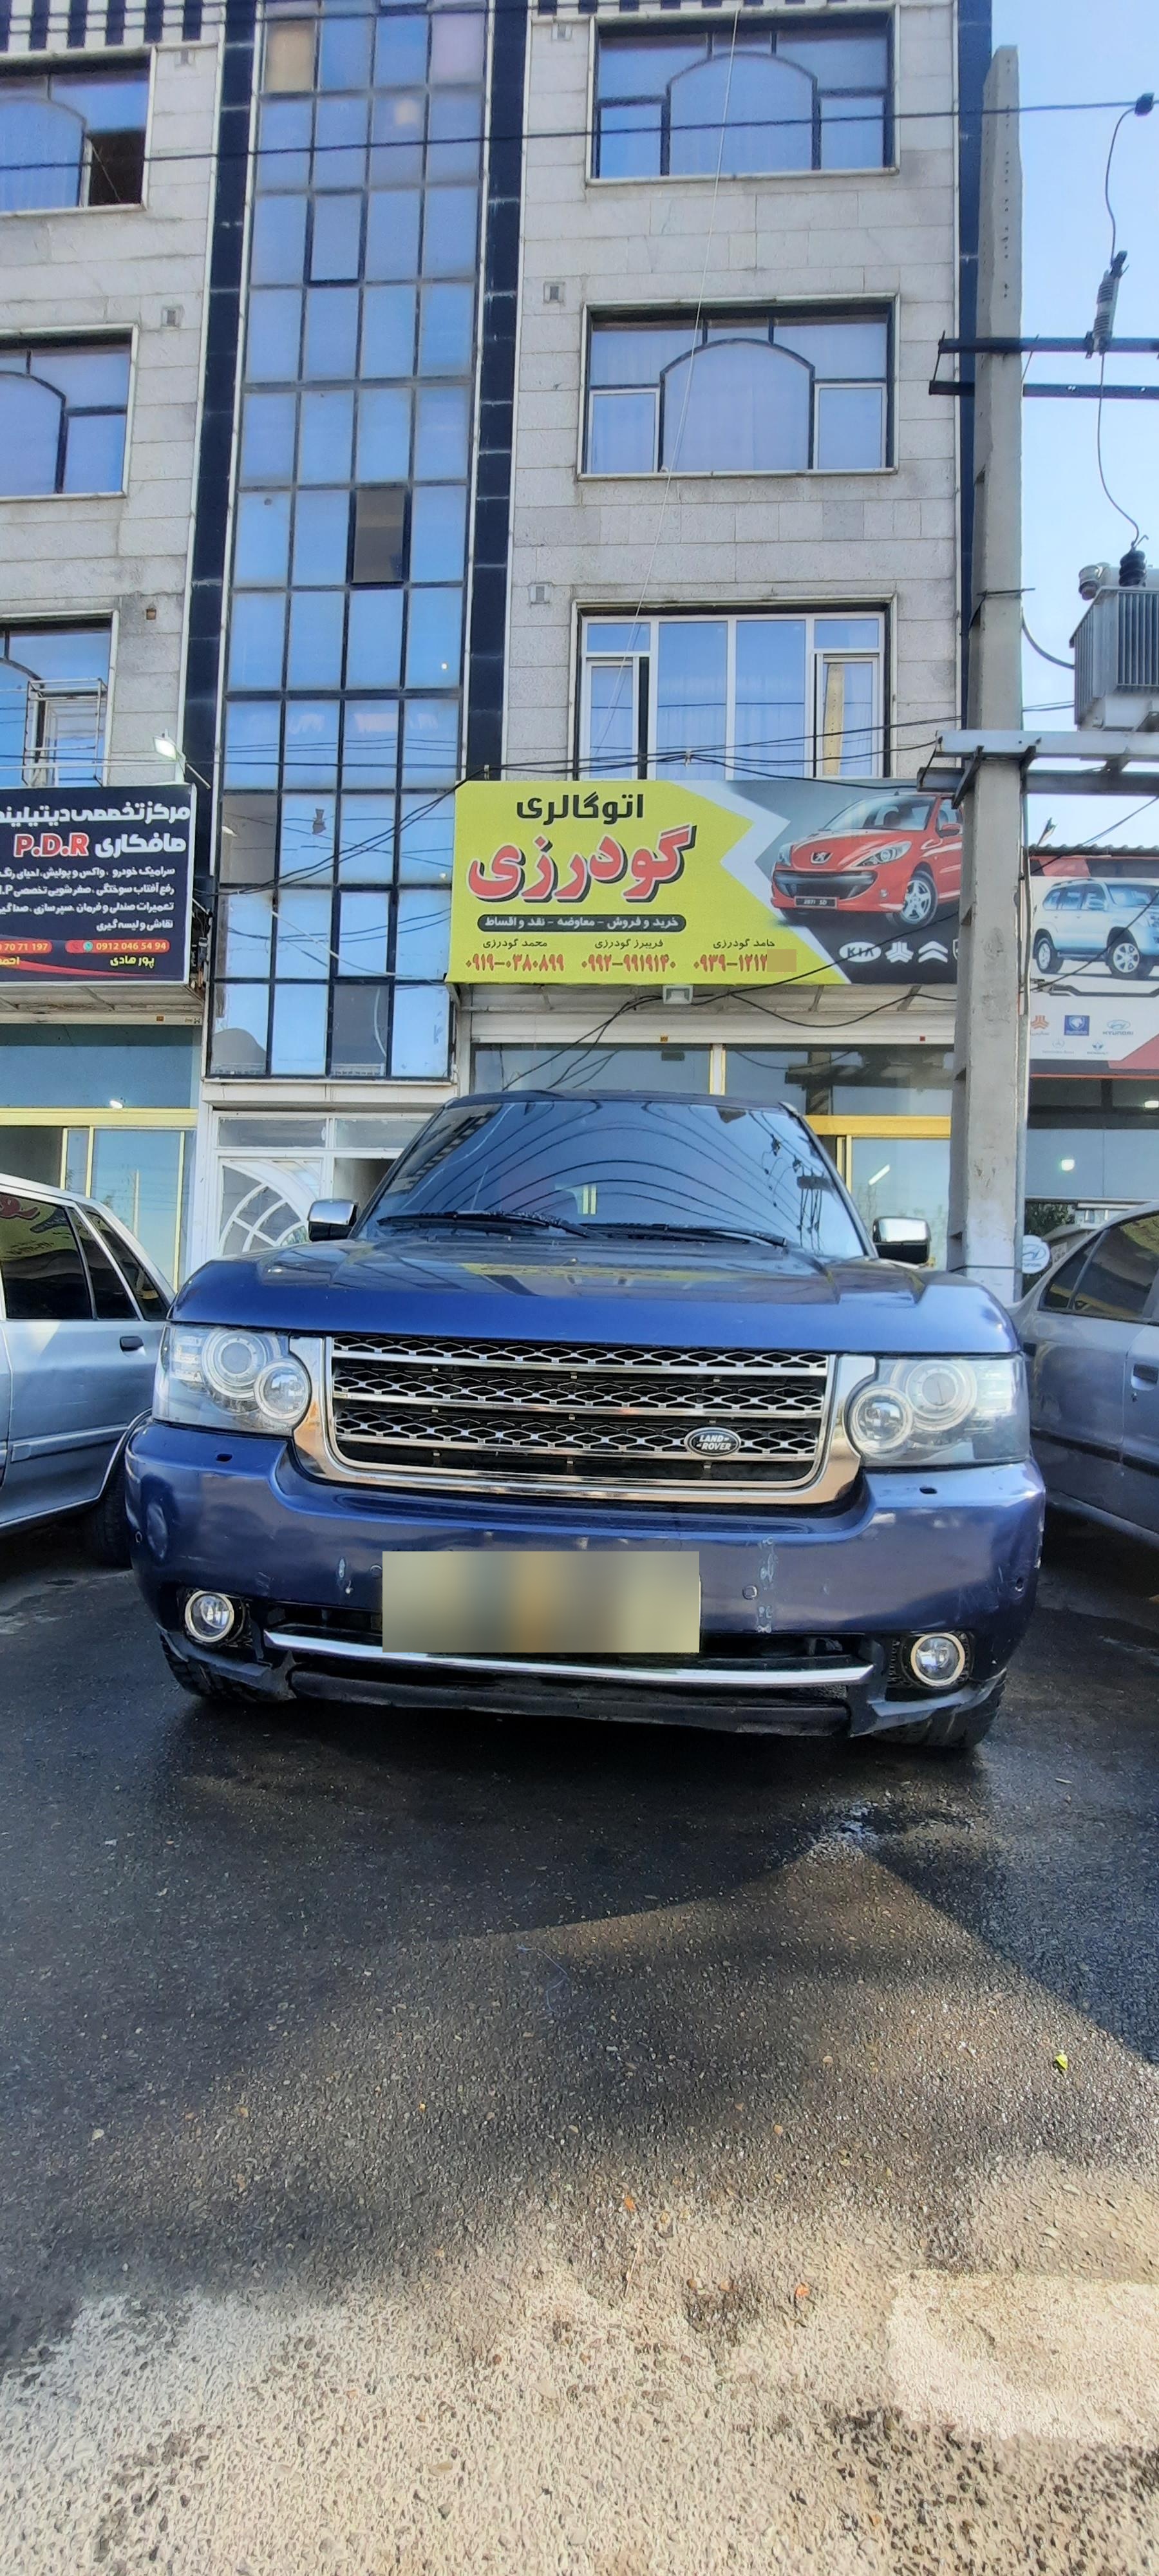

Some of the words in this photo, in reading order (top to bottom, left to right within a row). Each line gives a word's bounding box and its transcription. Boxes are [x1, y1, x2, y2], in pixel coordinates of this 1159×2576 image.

[71, 802, 145, 822] تخصصی
[145, 801, 191, 824] مرکز
[516, 791, 644, 826] اتوگالری
[14, 832, 89, 858] P.D.R
[95, 832, 187, 858] صافکاری
[467, 824, 697, 903] گودرزی
[72, 869, 79, 879] و
[112, 866, 138, 878] خودرو
[138, 866, 176, 878] سرامیک
[133, 882, 160, 895] آفتاب
[159, 884, 175, 896] رفع
[76, 902, 102, 914] فرمان
[102, 904, 109, 914] و
[109, 902, 135, 914] صندلی
[137, 902, 174, 914] تعمیرات
[140, 922, 146, 931] و
[485, 916, 516, 926] اقساط
[518, 919, 524, 929] و
[527, 917, 545, 926] نقد
[557, 916, 595, 929] معاوضه
[607, 916, 641, 929] فروش
[643, 919, 650, 929] و
[652, 916, 679, 929] خرید
[96, 942, 119, 951] 0912
[121, 942, 138, 951] 046
[141, 942, 153, 951] 54
[155, 942, 167, 951] 94
[482, 938, 519, 950] گودرزی
[594, 938, 631, 950] گودرزی
[633, 938, 664, 949] فریبرز
[713, 938, 750, 950] گودرزی
[753, 938, 775, 947] حامد
[847, 947, 874, 957] KIA
[0, 956, 20, 965] احم
[109, 956, 137, 967] هادی
[138, 957, 155, 969] پور
